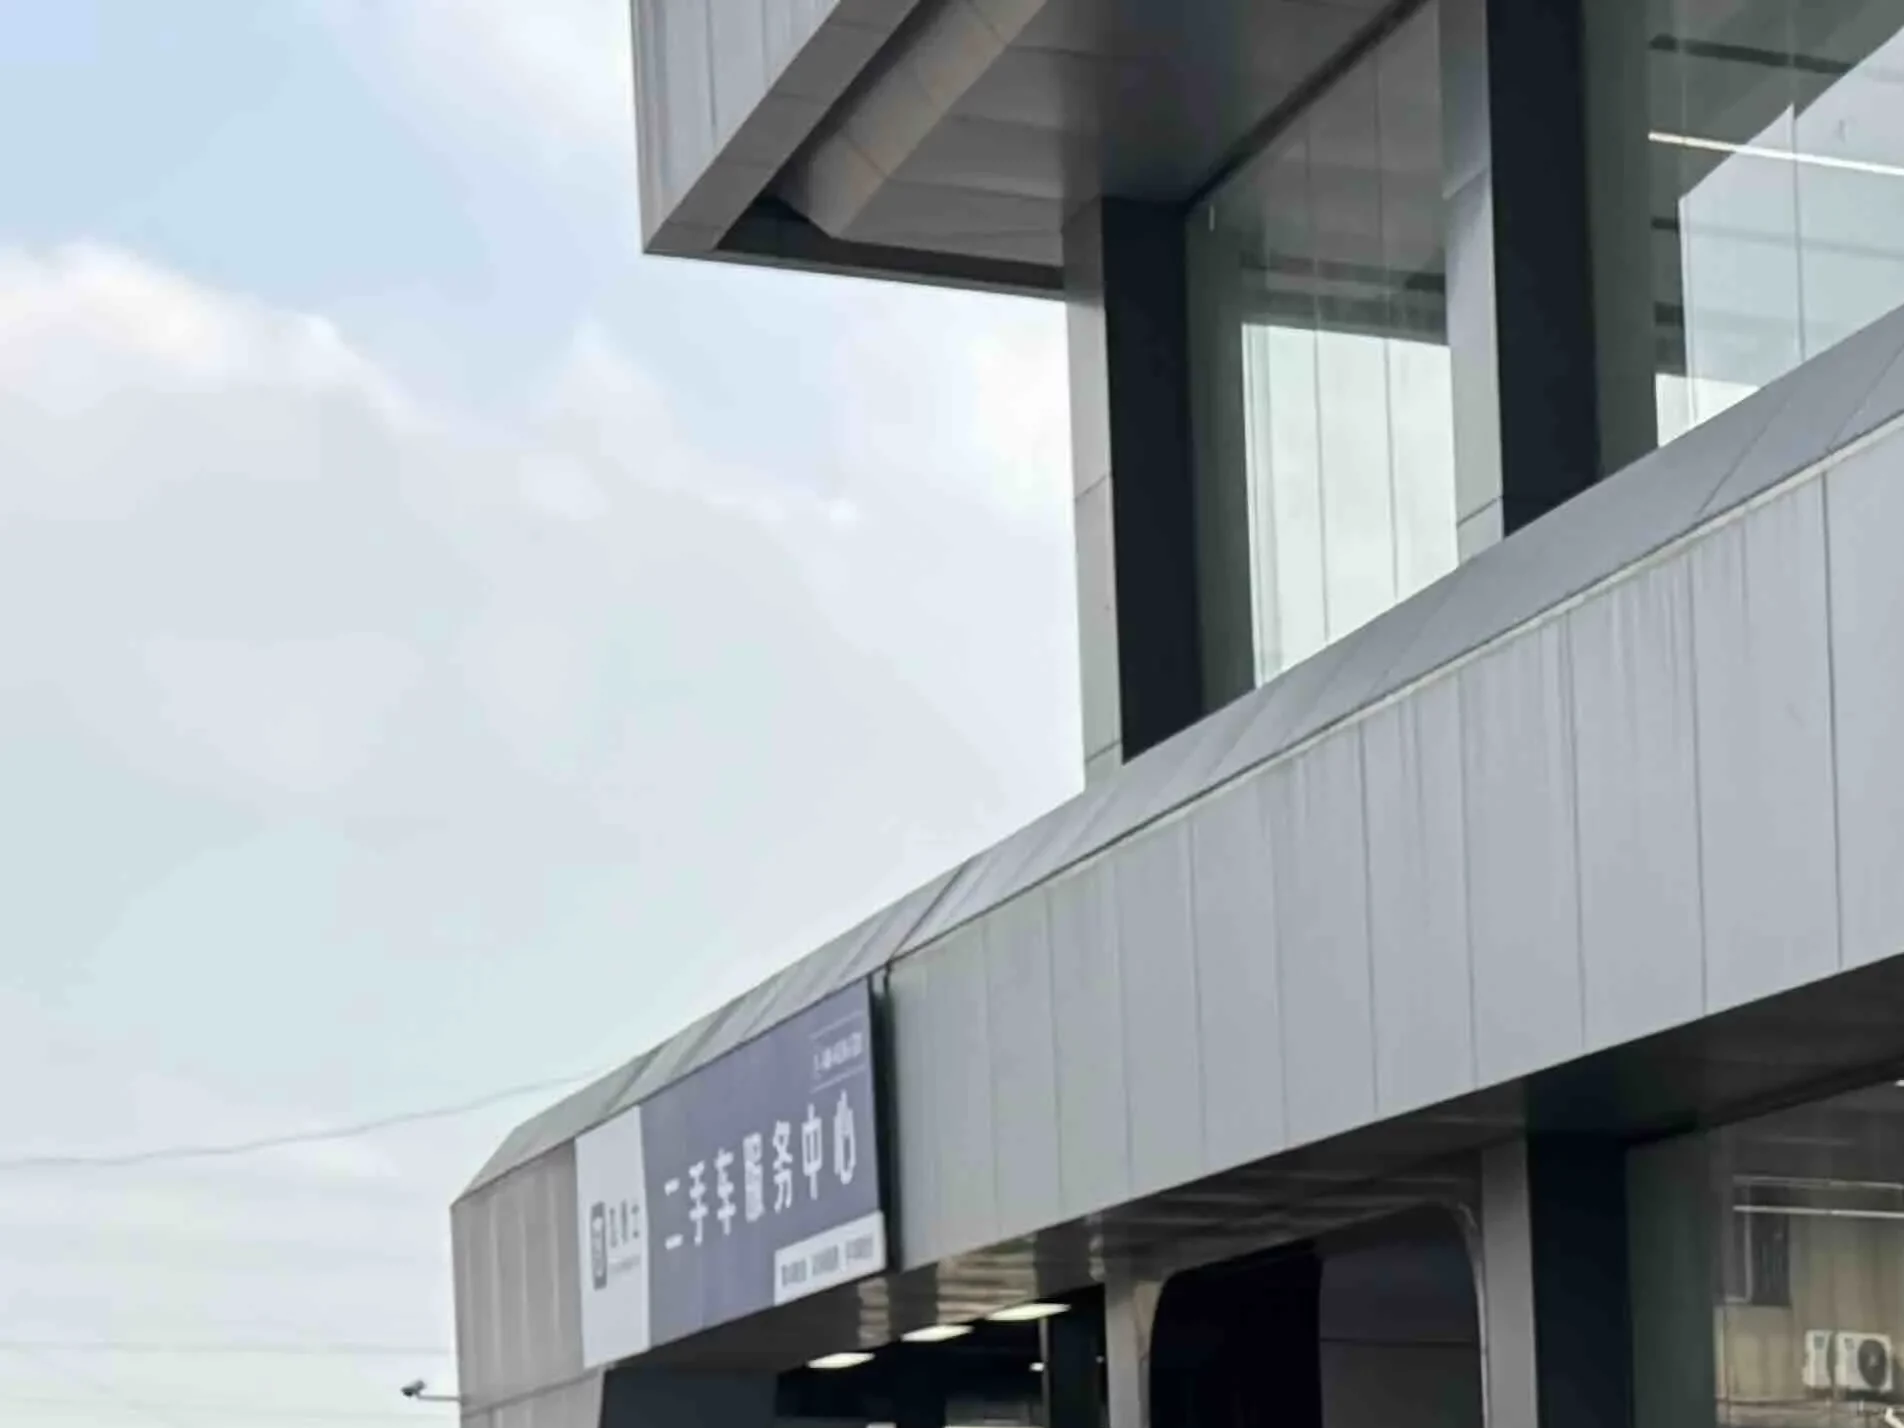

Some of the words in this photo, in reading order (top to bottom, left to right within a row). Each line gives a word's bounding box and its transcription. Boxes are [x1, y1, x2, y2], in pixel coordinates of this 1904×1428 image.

[664, 1089, 857, 1250] 二手车服务中心
